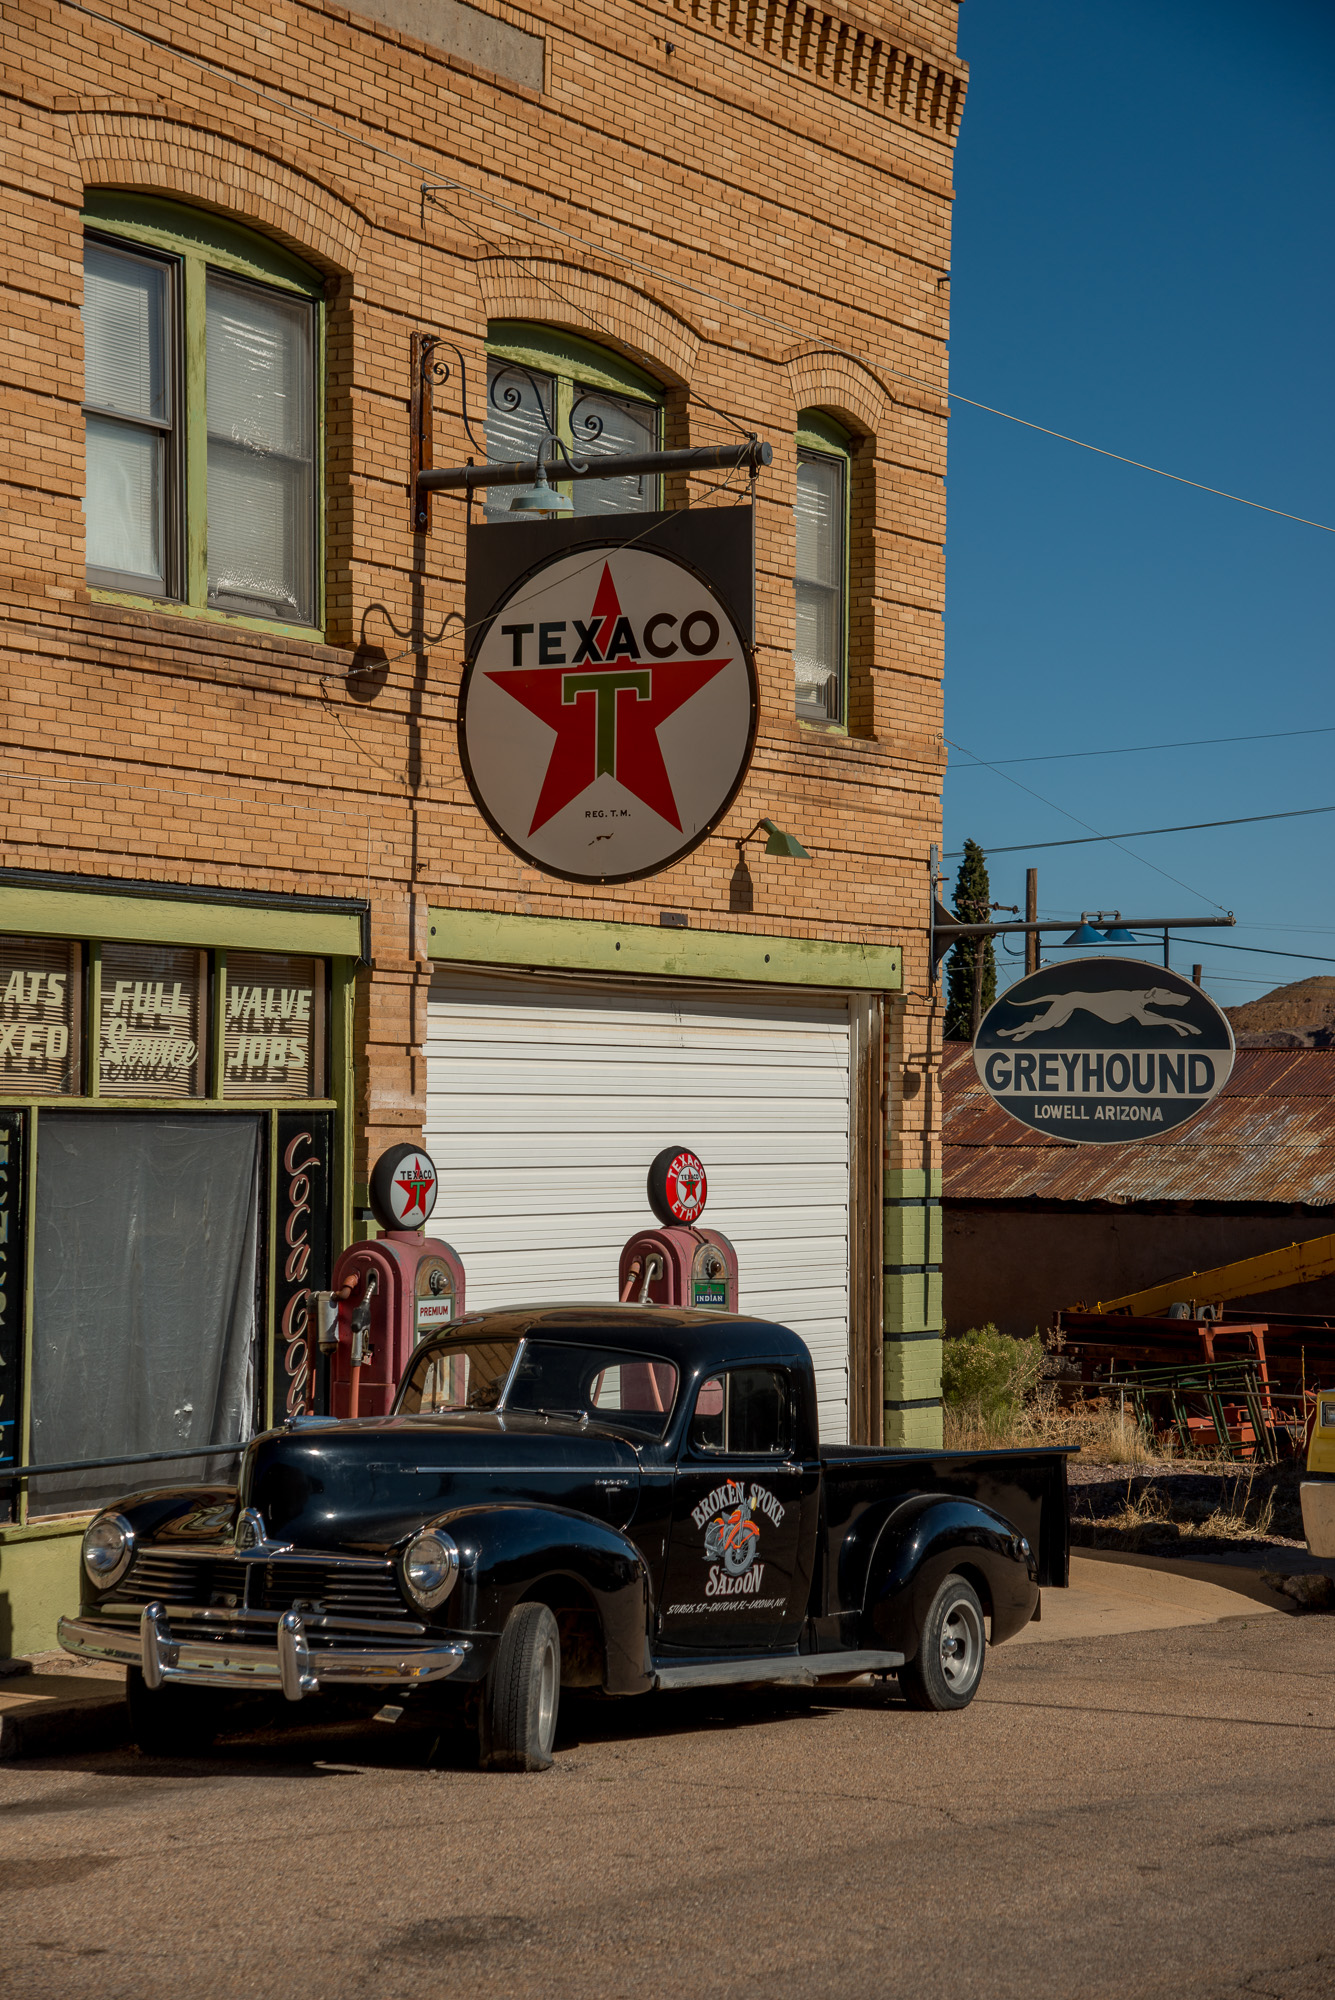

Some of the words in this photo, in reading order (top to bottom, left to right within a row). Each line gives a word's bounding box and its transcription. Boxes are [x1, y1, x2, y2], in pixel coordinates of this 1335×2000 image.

[501, 610, 720, 667] TEXACO
[585, 810, 608, 818] REG.
[0, 971, 67, 1006] ATS
[113, 981, 188, 1015] FULL
[230, 986, 313, 1021] VALVE
[103, 1017, 199, 1067] Service
[228, 1035, 308, 1068] JOBS
[985, 1052, 1215, 1094] GREYHOUND
[1034, 1104, 1090, 1120] LOWELL
[1094, 1105, 1164, 1122] ARIZONA
[400, 1169, 432, 1180] TEXACO
[668, 1154, 705, 1180] TEXACO
[671, 1200, 705, 1221] ETHYL
[420, 1305, 449, 1317] PREMIUM
[691, 1481, 746, 1531] BROKEN
[750, 1483, 786, 1528] SPOKE
